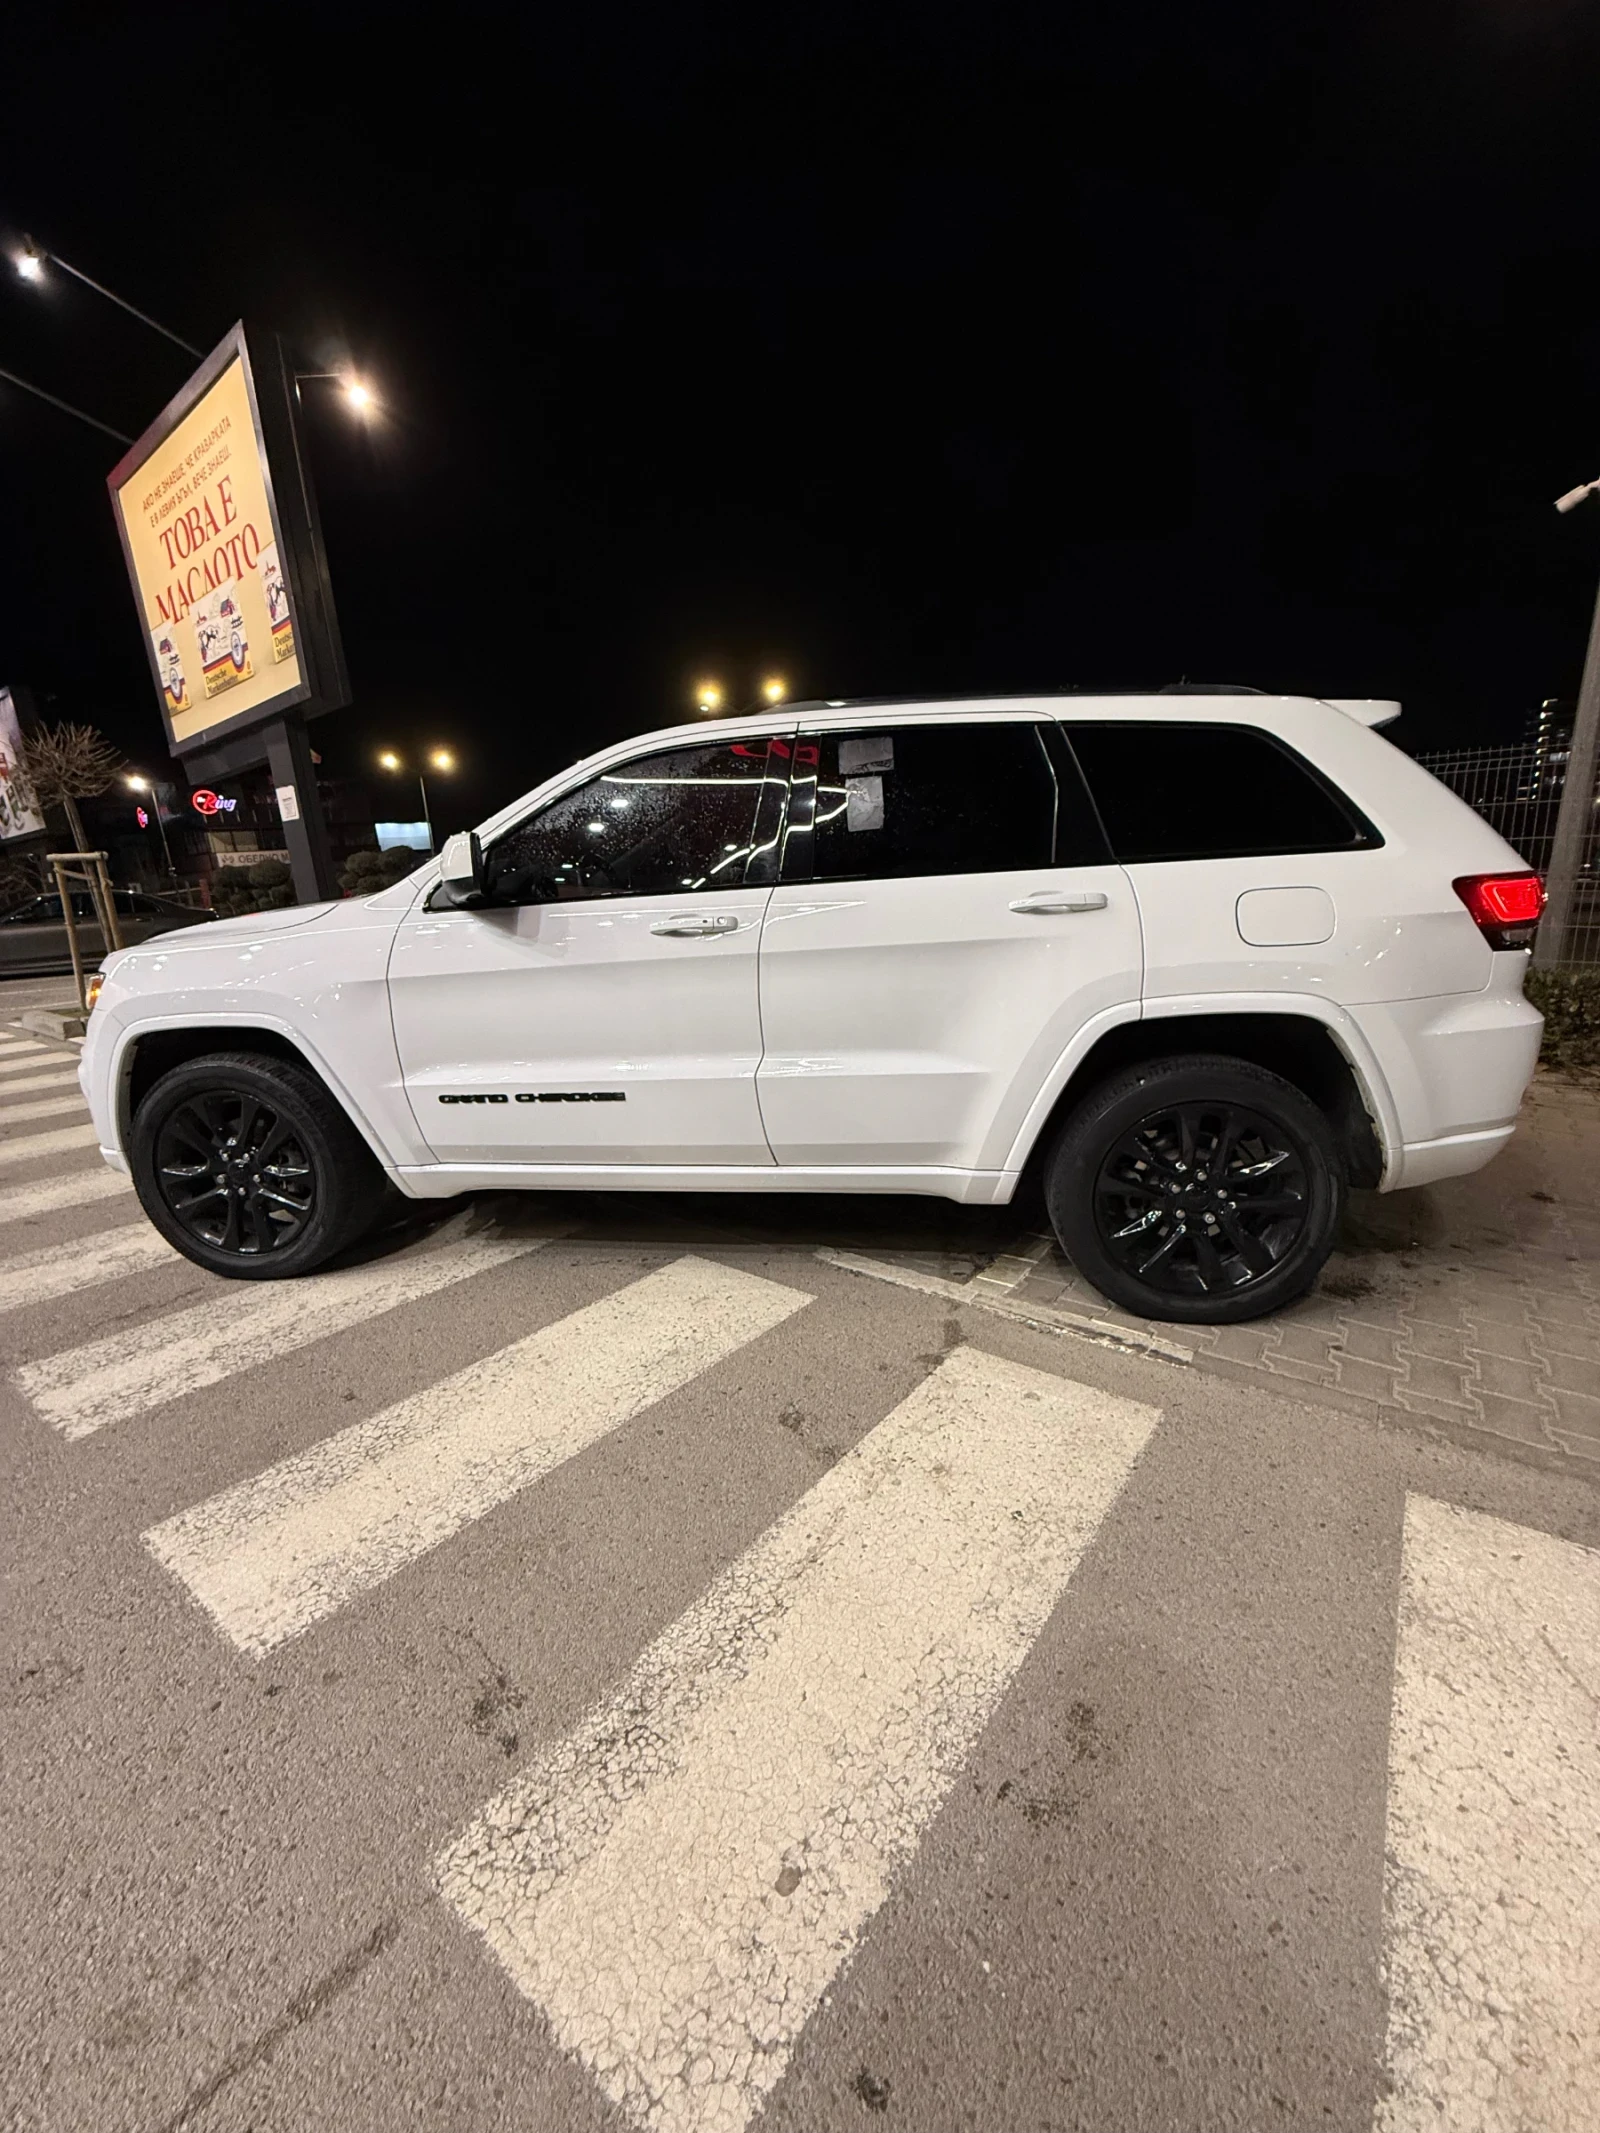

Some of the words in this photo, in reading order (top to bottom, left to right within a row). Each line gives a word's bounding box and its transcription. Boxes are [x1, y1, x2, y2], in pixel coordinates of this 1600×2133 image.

[142, 493, 154, 514] АКО
[153, 485, 163, 500] НЕ
[193, 415, 231, 461] КРАВАРКАТА
[158, 496, 177, 521] ЛЕВИЯ
[192, 466, 208, 490] ВЕЧЕ
[159, 495, 222, 570] ТОВА
[217, 474, 238, 527] Е
[155, 523, 261, 625] МАСЛОТО
[202, 794, 237, 812] Ring
